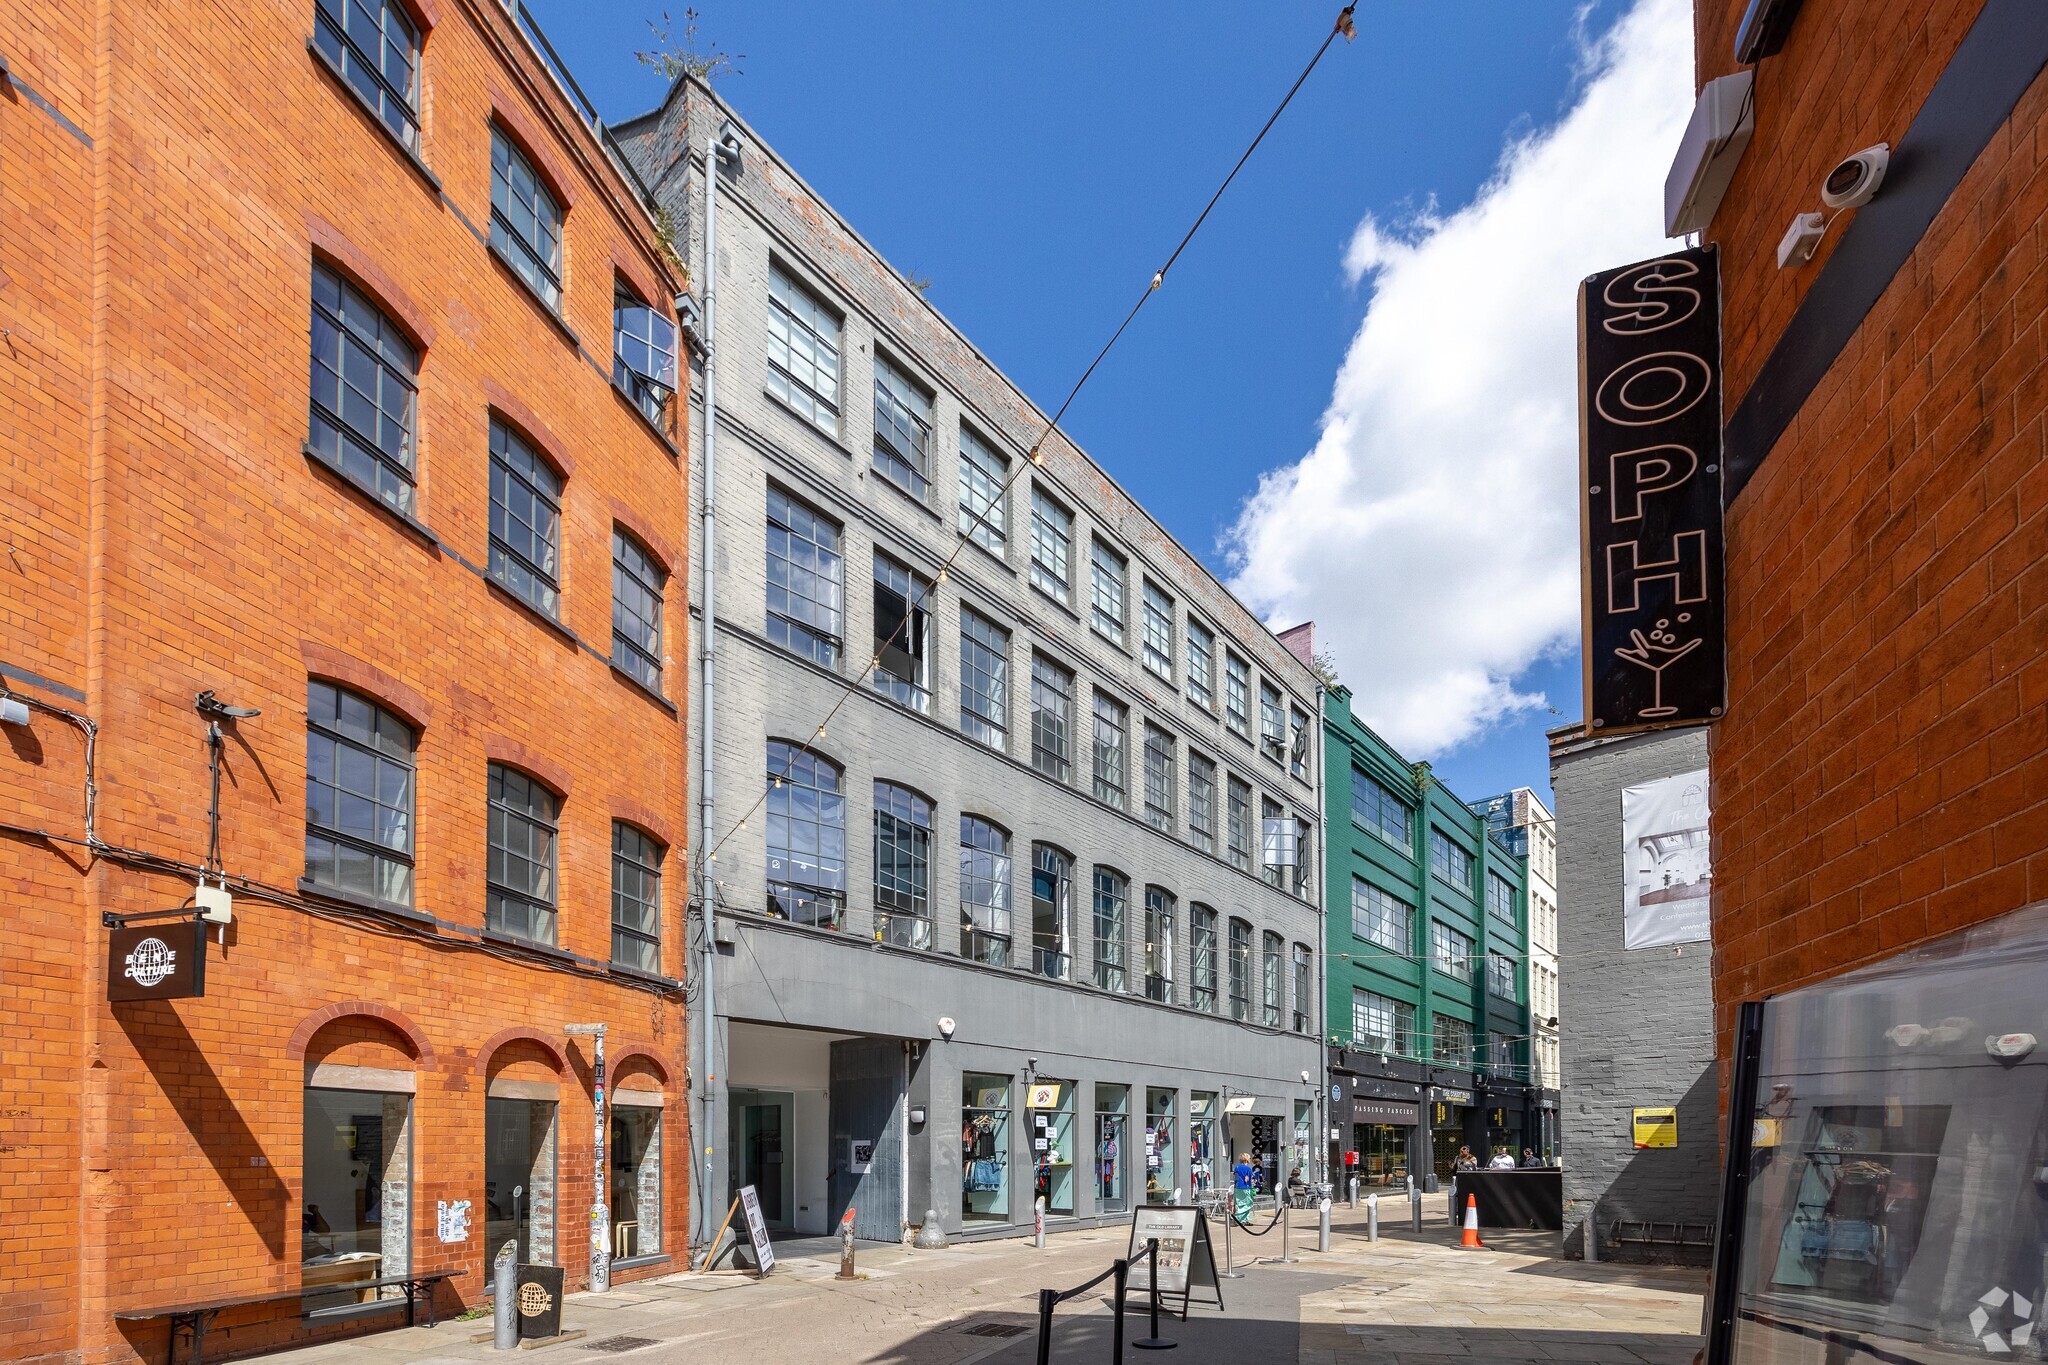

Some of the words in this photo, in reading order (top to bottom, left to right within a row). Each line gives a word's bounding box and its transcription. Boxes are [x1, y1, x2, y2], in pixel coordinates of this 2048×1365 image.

[124, 950, 177, 965] BENE
[124, 964, 176, 978] CULTURE
[1354, 1105, 1384, 1113] PASSING
[1387, 1107, 1413, 1115] FANCIES
